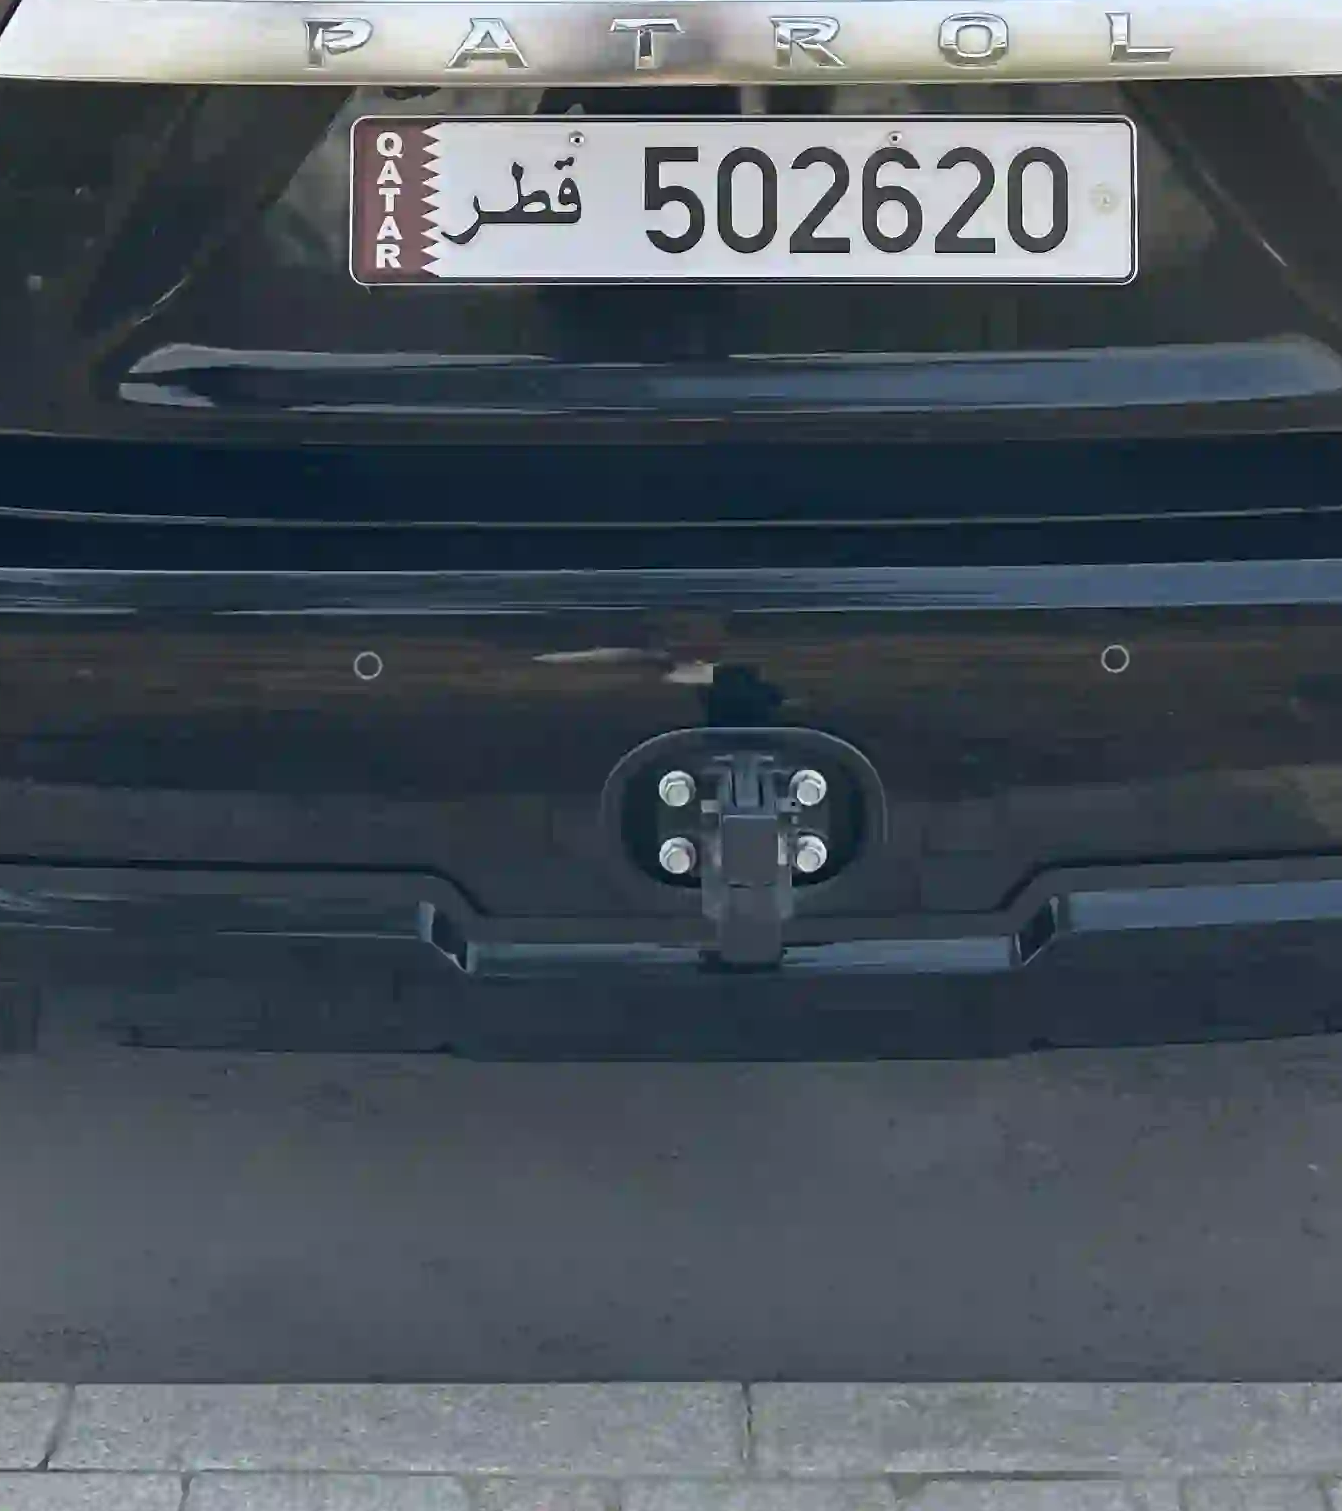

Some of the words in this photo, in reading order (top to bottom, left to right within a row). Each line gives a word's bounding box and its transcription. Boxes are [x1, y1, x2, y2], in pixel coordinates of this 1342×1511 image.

[303, 11, 1175, 70] PATROL
[375, 131, 404, 270] QATAR
[440, 156, 583, 246] قطر
[643, 145, 1070, 255] 502620
